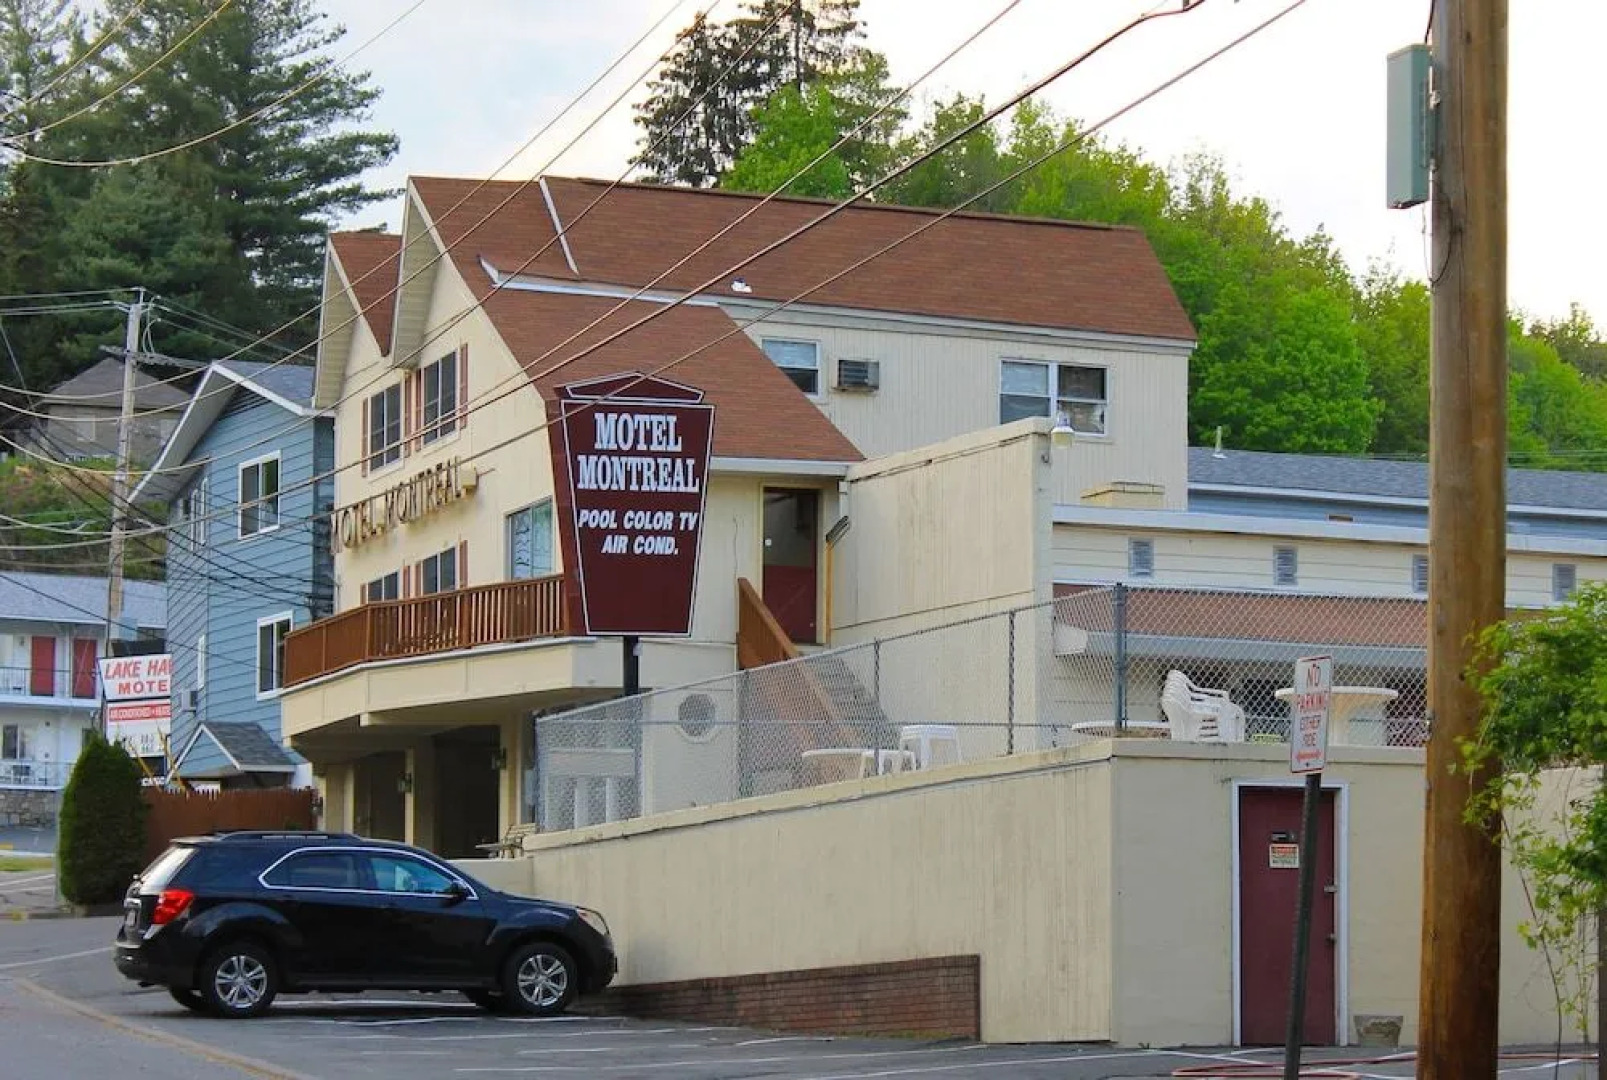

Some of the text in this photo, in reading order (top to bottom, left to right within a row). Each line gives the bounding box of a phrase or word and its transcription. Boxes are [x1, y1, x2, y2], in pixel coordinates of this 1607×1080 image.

[594, 412, 682, 452] MOTEL
[577, 454, 699, 493] MONTREAL
[578, 509, 699, 531] POOL COLOR TV
[601, 534, 679, 555] AIR COND.
[104, 661, 141, 679] LAKE
[1306, 663, 1321, 687] NO
